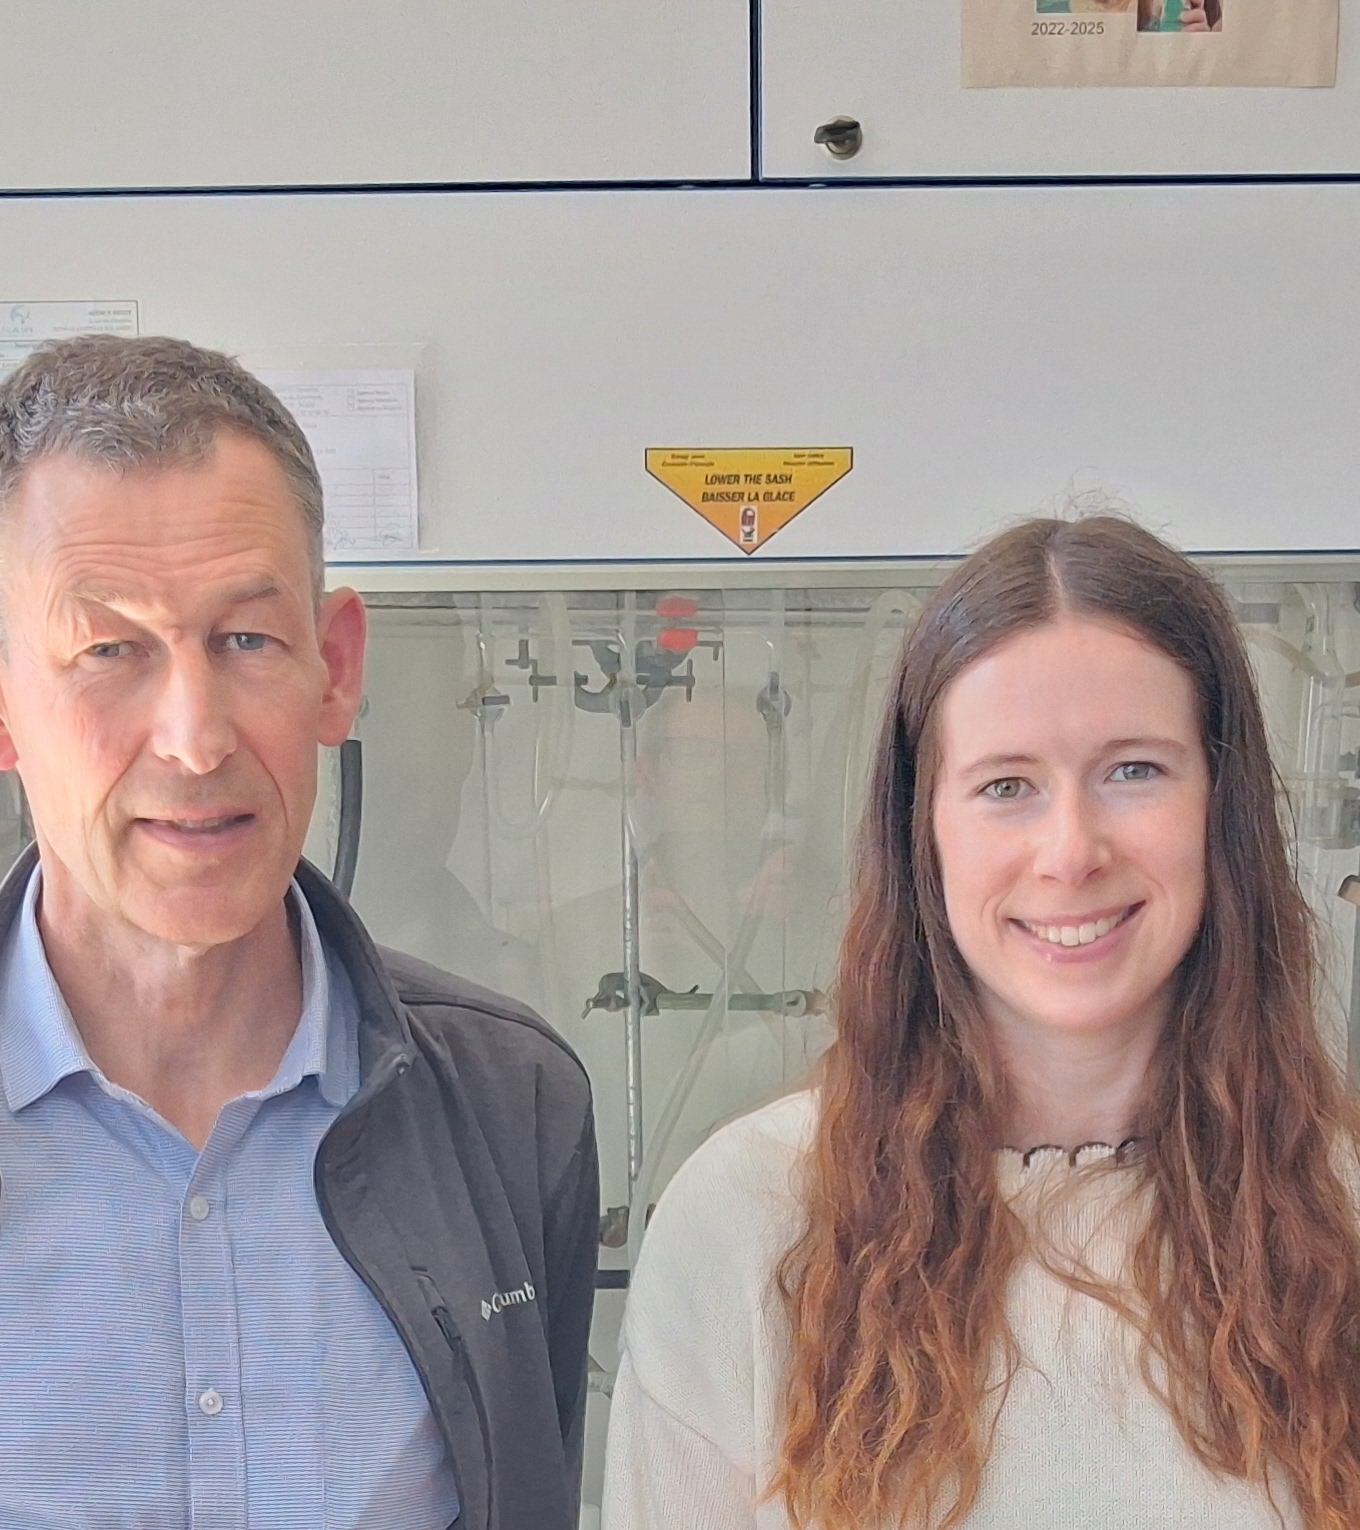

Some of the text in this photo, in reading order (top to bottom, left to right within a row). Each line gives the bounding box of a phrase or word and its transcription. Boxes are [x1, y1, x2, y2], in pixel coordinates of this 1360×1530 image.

[1031, 21, 1104, 36] 2022-2025
[704, 473, 793, 486] LOWER THE SASH
[701, 491, 796, 503] BAISSER LA GLACE
